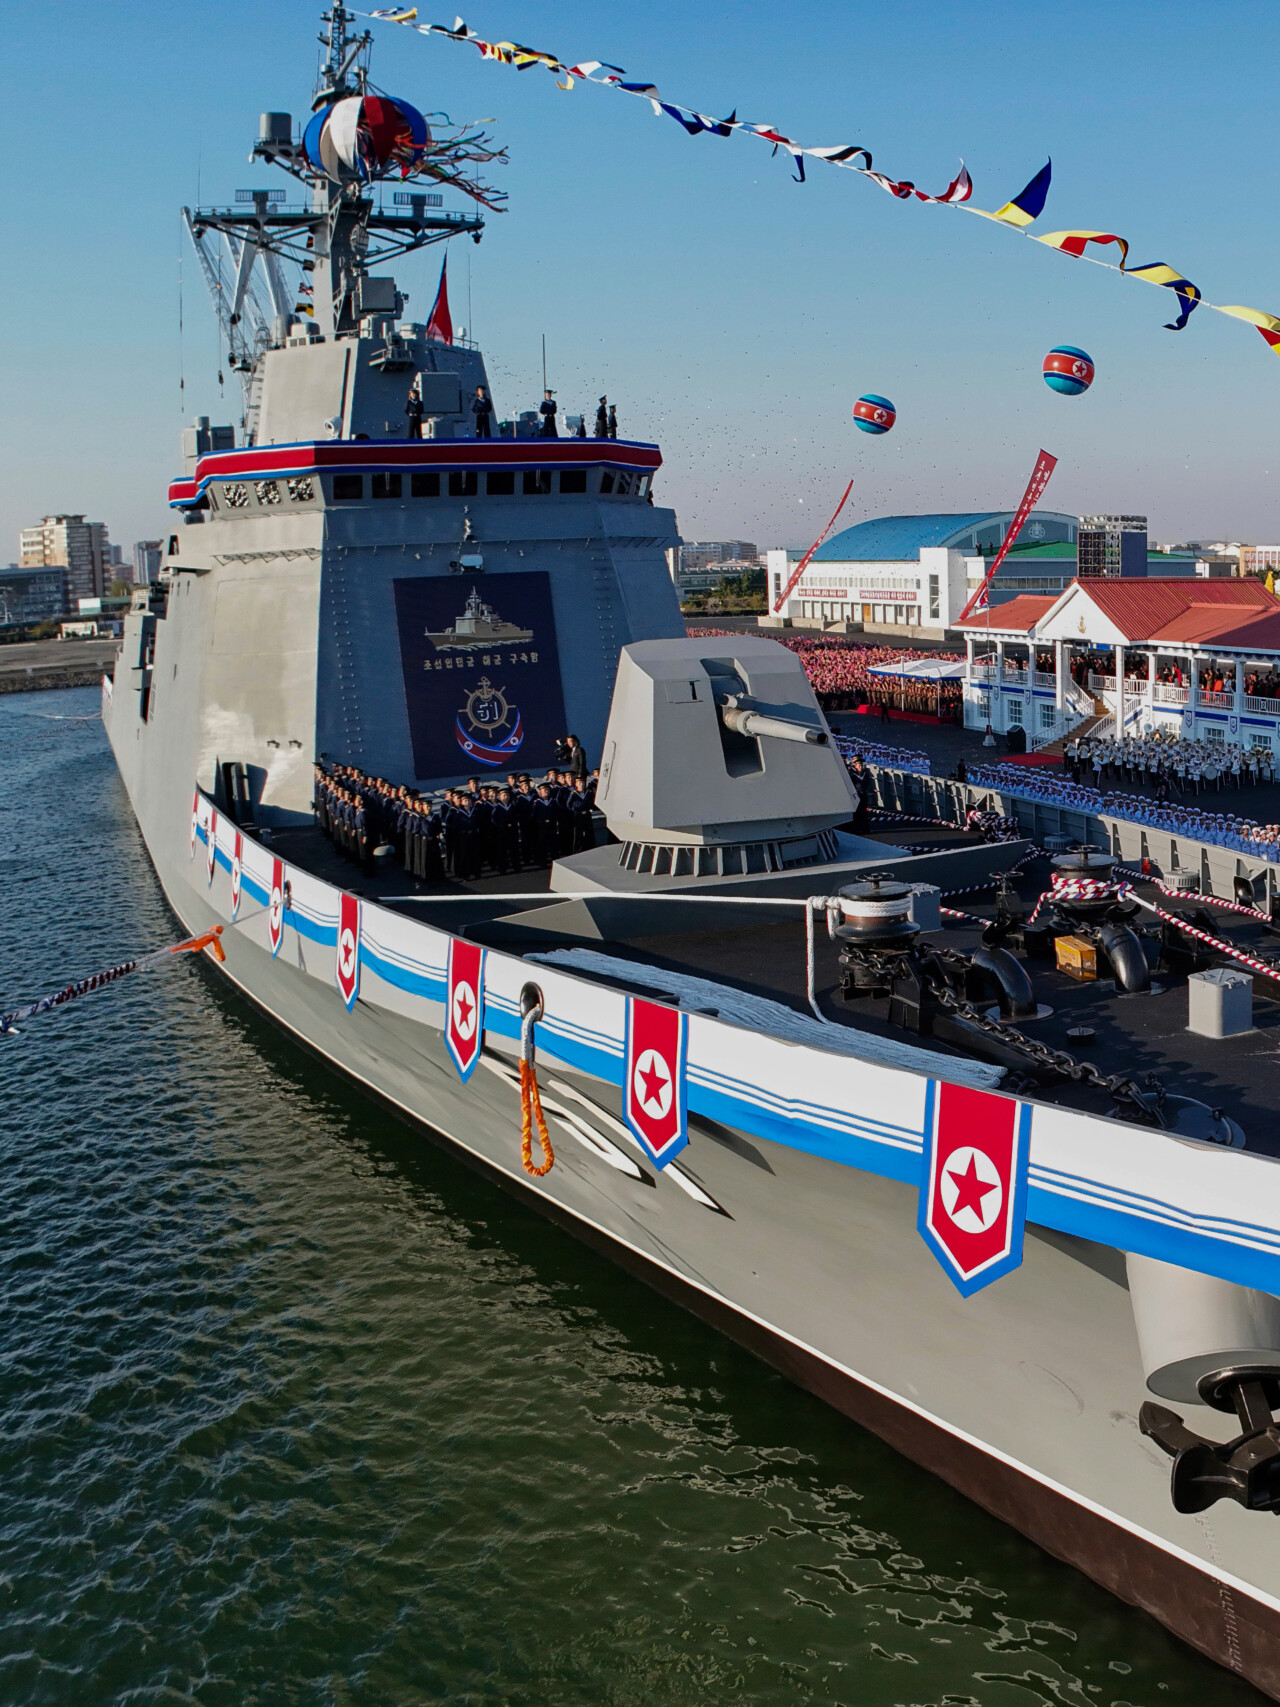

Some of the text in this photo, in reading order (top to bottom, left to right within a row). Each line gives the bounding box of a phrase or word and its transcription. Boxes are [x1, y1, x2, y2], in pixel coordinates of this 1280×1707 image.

[423, 651, 539, 671] 조선인민군 해군 구축함
[477, 701, 500, 722] 51
